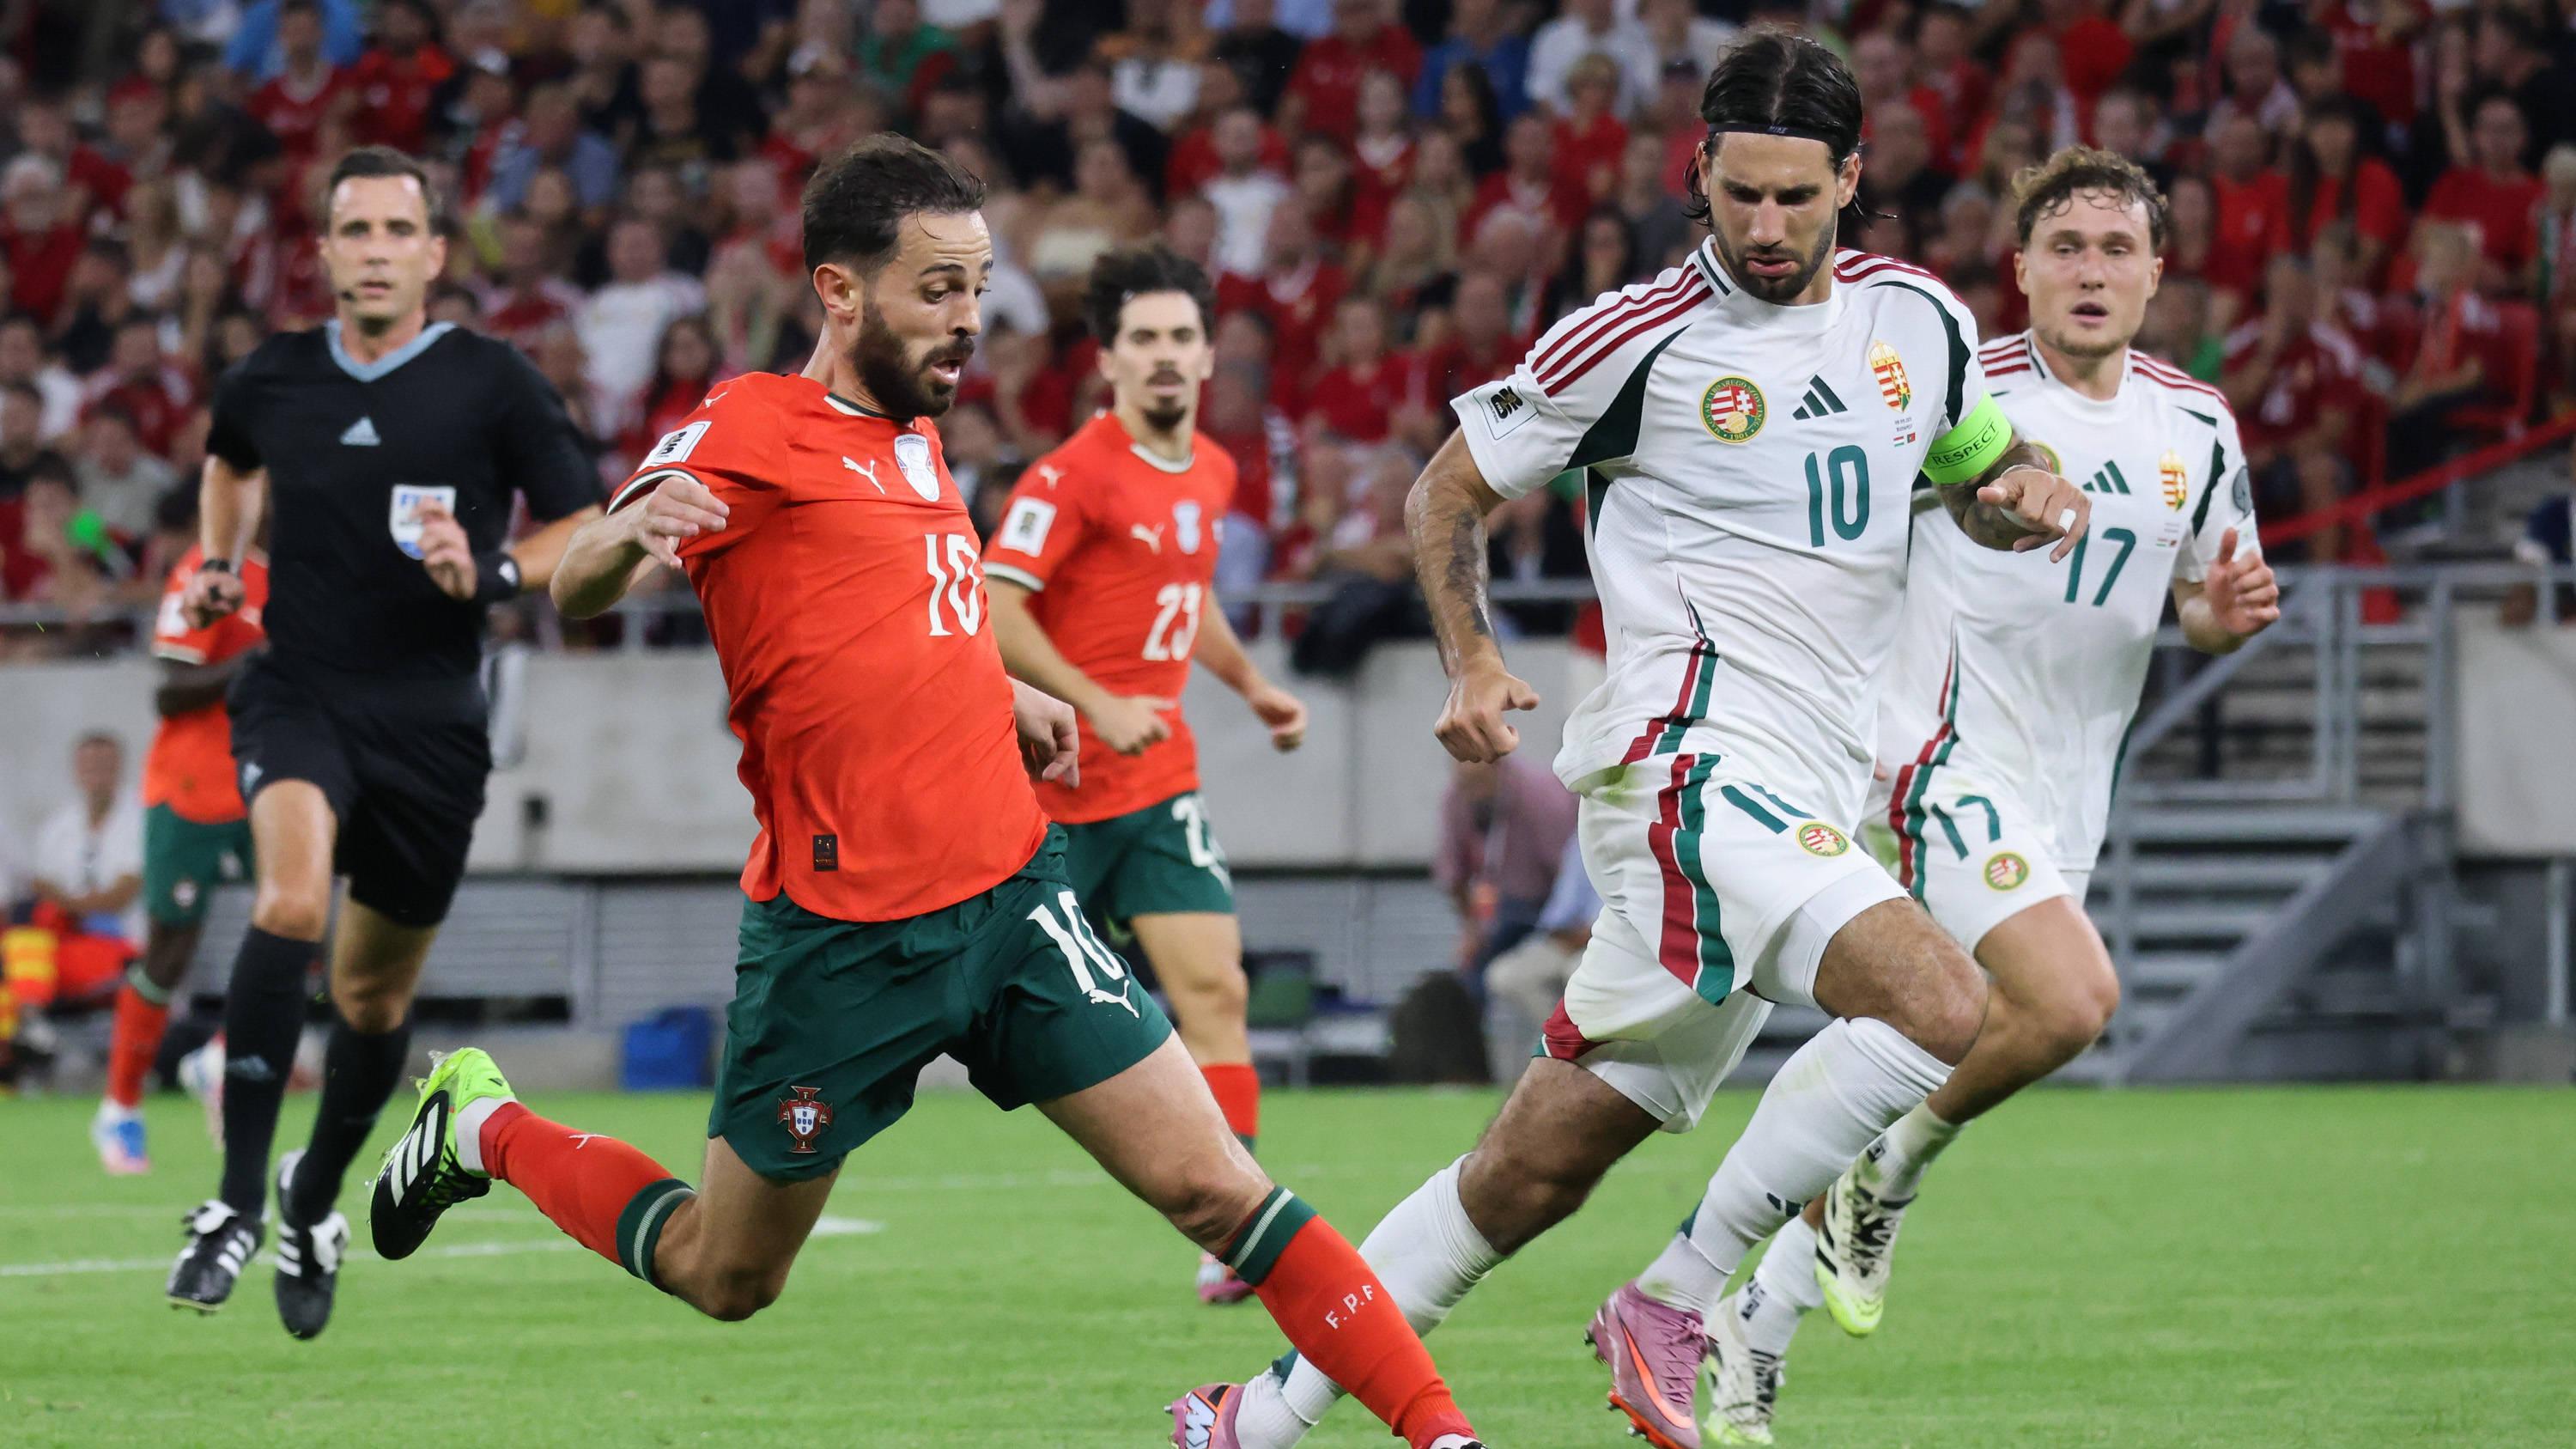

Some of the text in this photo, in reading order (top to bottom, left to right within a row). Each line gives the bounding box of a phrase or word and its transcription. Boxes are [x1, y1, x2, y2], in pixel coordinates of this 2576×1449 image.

[1932, 421, 1996, 465] RESPECT
[1804, 445, 1869, 547] 10
[925, 534, 980, 636] 10
[2064, 524, 2136, 606] 17
[1141, 582, 1201, 661] 23
[1930, 795, 2002, 861] 17
[1026, 891, 1125, 994] 10
